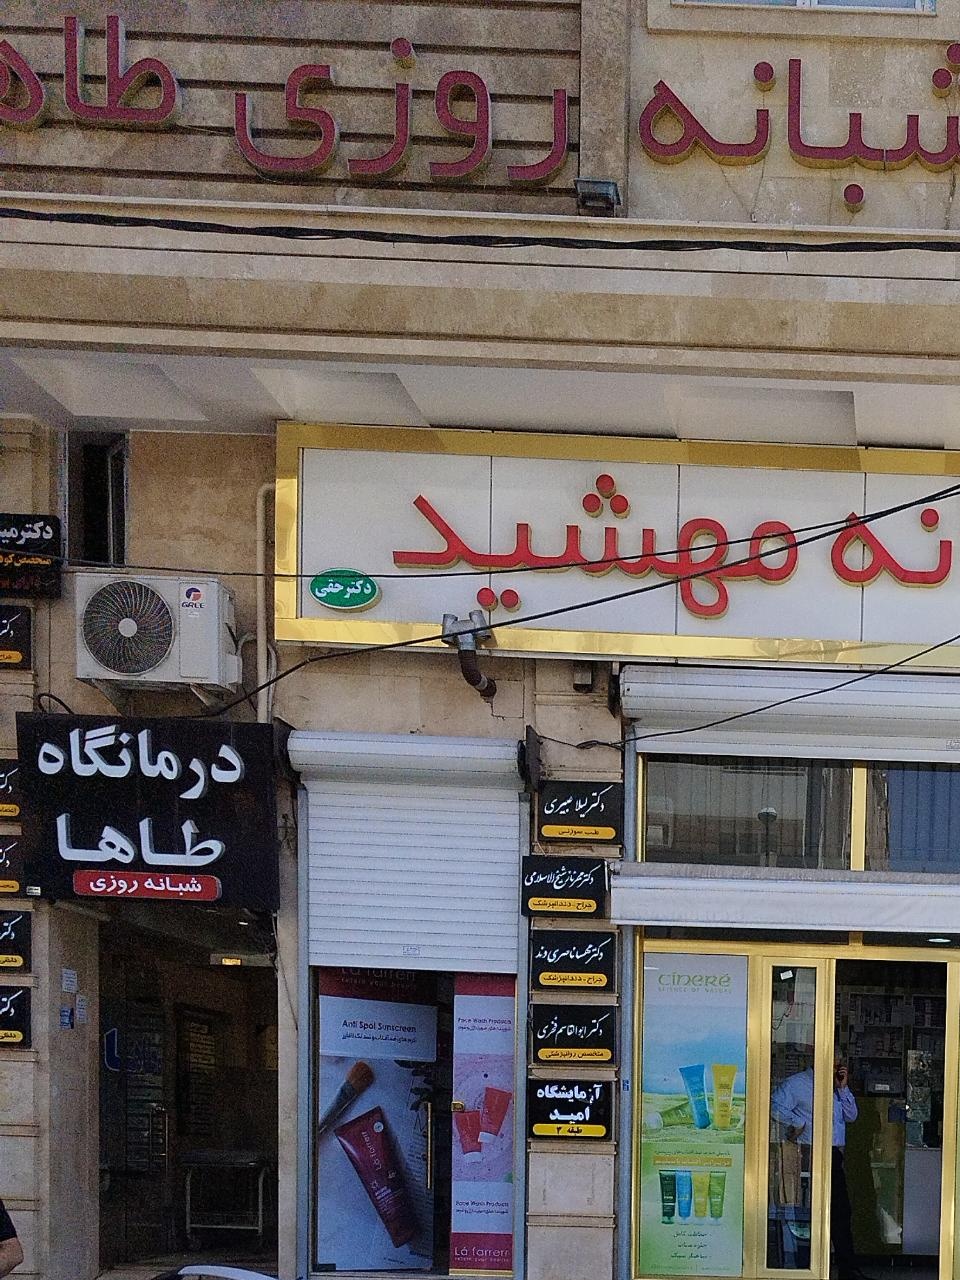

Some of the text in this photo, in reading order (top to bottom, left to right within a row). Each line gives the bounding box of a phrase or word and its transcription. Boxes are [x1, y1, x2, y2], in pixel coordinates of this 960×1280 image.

[0, 16, 176, 124] طاه
[234, 38, 568, 180] روزی
[392, 475, 798, 618] مهشید
[315, 579, 371, 598] دکتر حقی
[38, 724, 244, 799] درمانگاه
[583, 785, 613, 815] دکتر
[56, 813, 226, 867] طاها
[89, 874, 202, 896] شبانه روزی
[585, 938, 611, 964] دکتر
[342, 1020, 358, 1028] Anti
[378, 1022, 417, 1032] Sunscreen
[585, 1013, 610, 1038] دکتر
[537, 1084, 603, 1104] آزمایشگاه
[549, 1106, 590, 1124] امید
